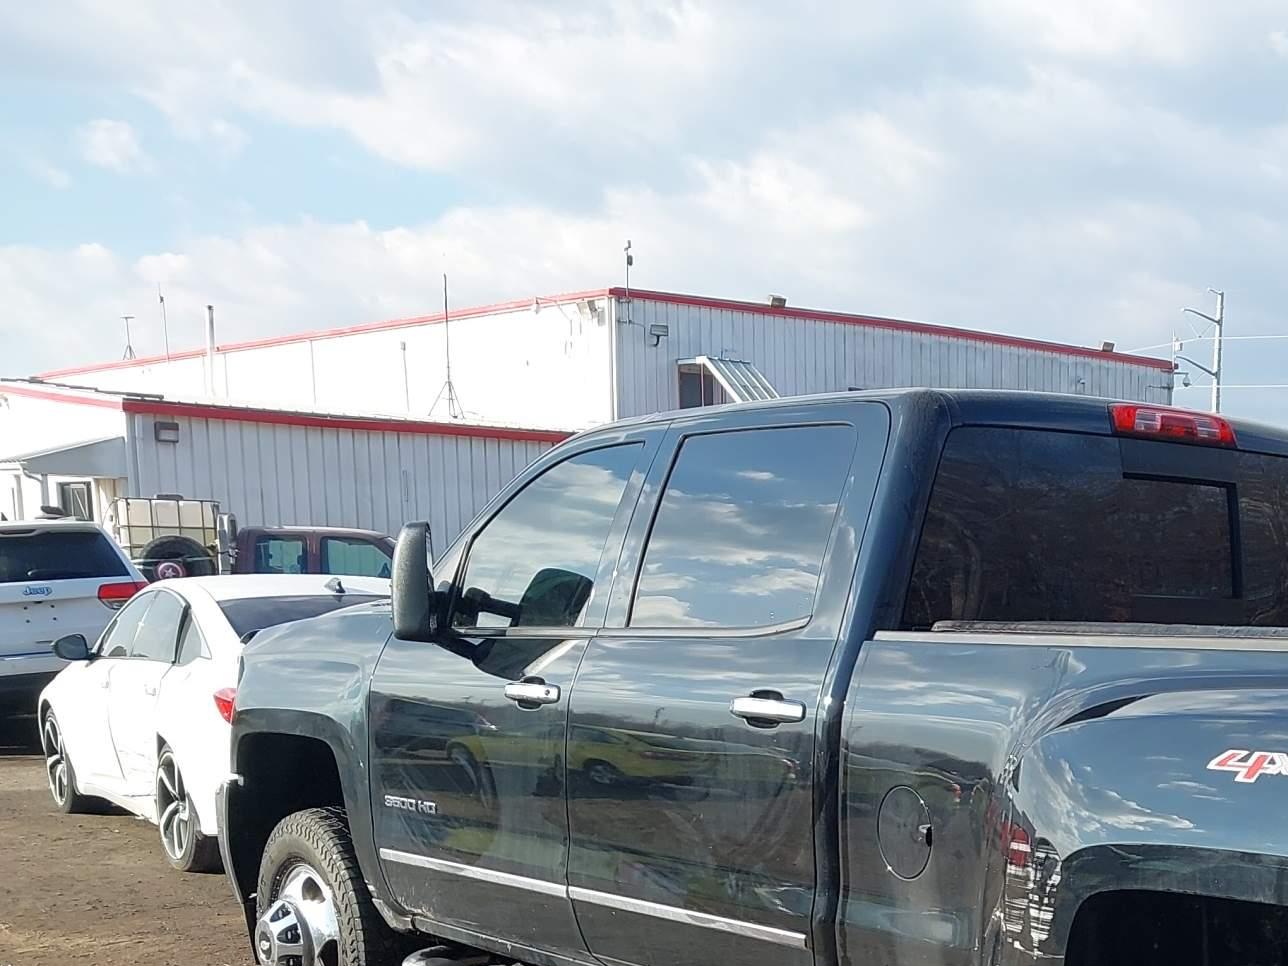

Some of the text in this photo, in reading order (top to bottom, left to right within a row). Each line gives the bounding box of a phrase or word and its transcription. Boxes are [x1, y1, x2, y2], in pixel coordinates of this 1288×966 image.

[23, 585, 52, 596] Jeep
[384, 794, 436, 815] 3500 HD
